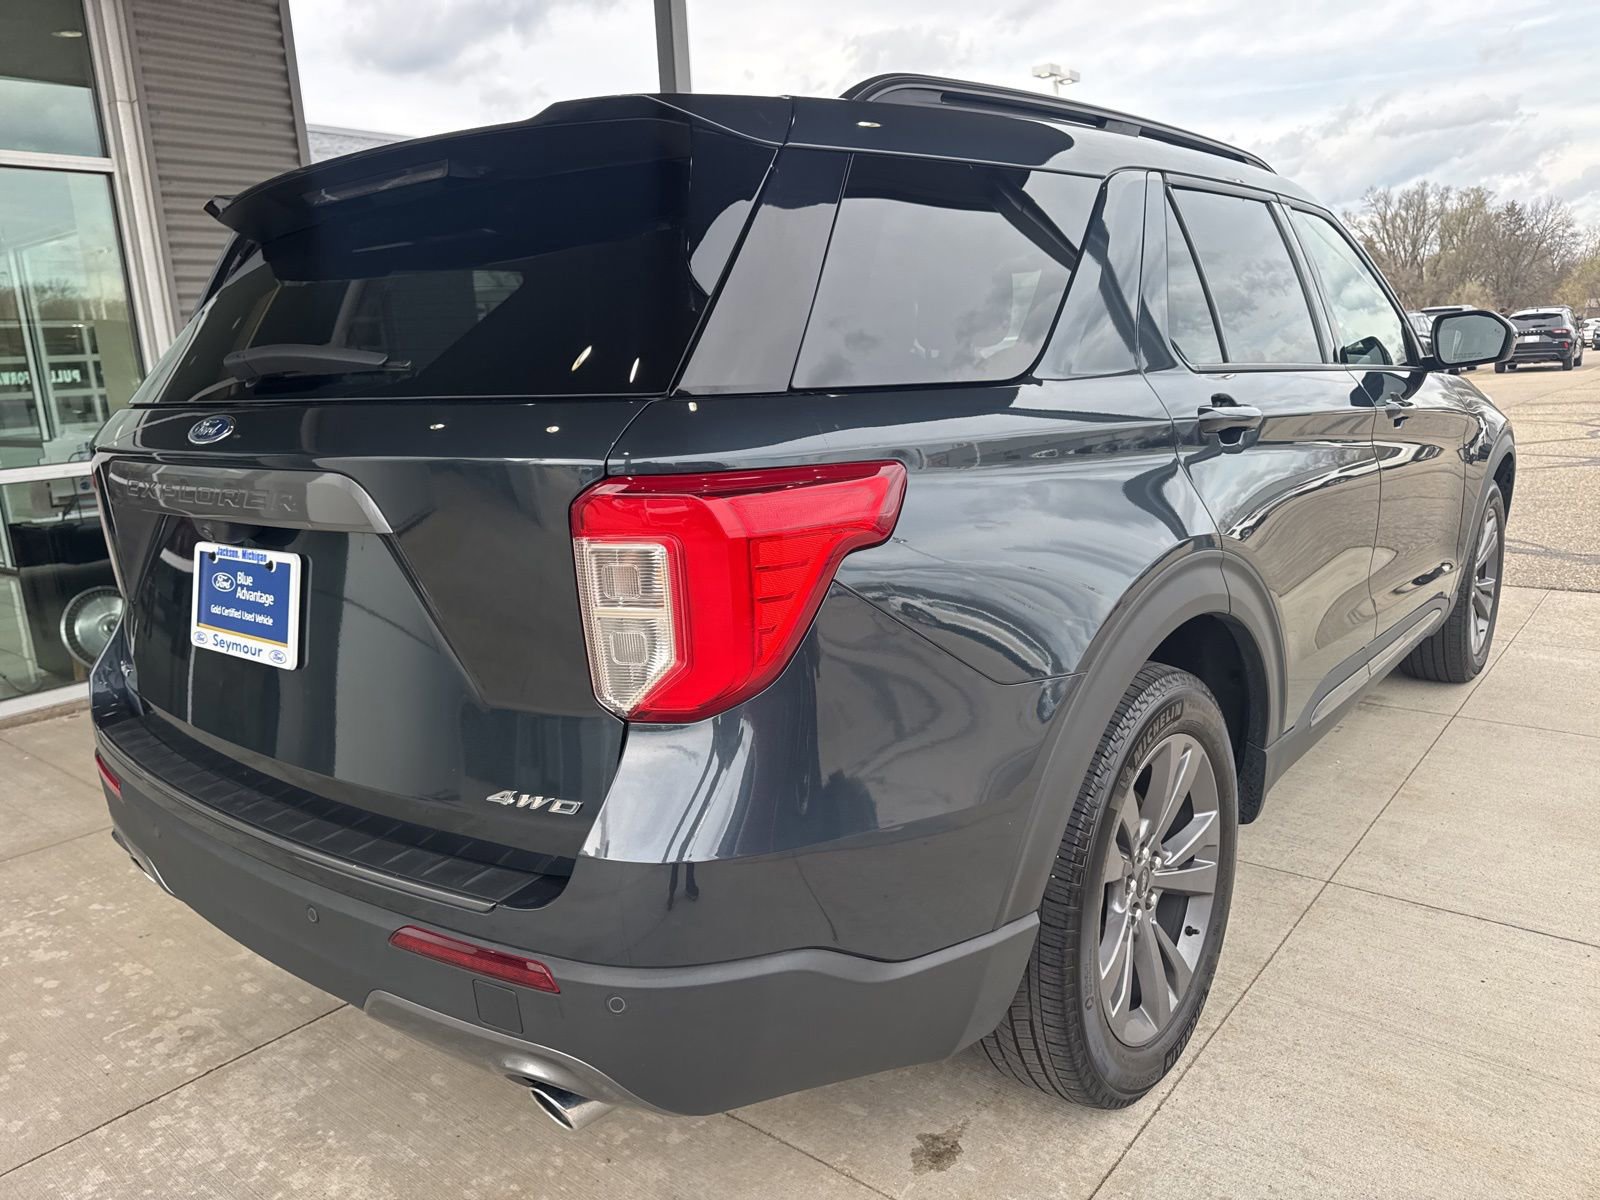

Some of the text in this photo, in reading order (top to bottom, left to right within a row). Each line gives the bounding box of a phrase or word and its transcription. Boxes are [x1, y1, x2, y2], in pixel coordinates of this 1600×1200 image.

[127, 479, 298, 513] EXPLORER
[241, 549, 267, 564] Michigan
[236, 571, 253, 586] Blue
[236, 586, 275, 607] Advantage
[210, 604, 274, 626] Gold Certified Used Vehicle
[212, 633, 263, 657] Seymour
[1133, 700, 1183, 765] MICHELIN
[485, 790, 584, 815] 4WD
